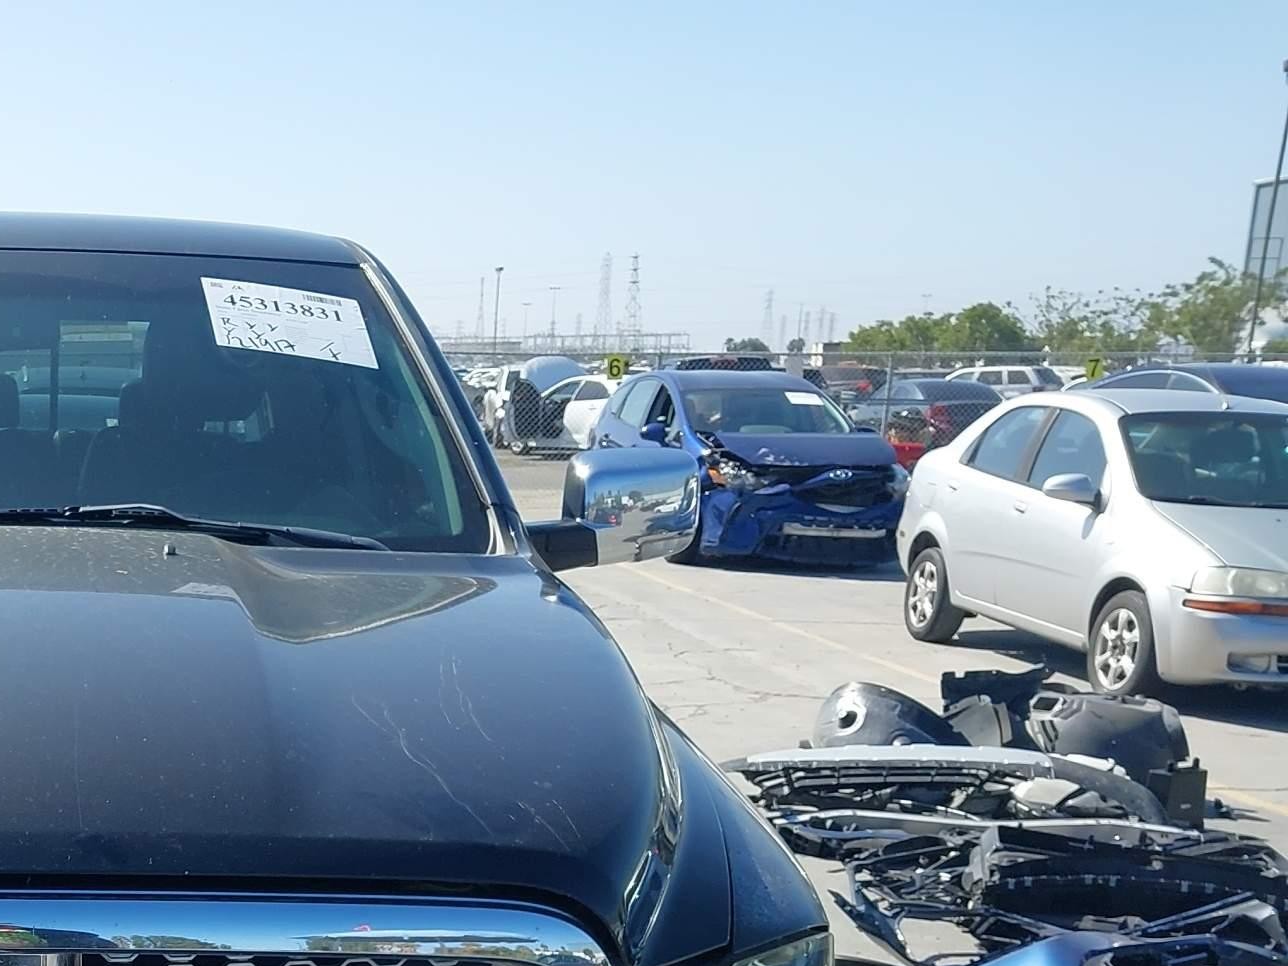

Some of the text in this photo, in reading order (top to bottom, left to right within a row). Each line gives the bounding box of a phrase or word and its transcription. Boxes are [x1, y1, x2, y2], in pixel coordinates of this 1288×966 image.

[223, 294, 343, 323] 45313831
[609, 358, 621, 377] 6
[1088, 359, 1101, 377] 7
